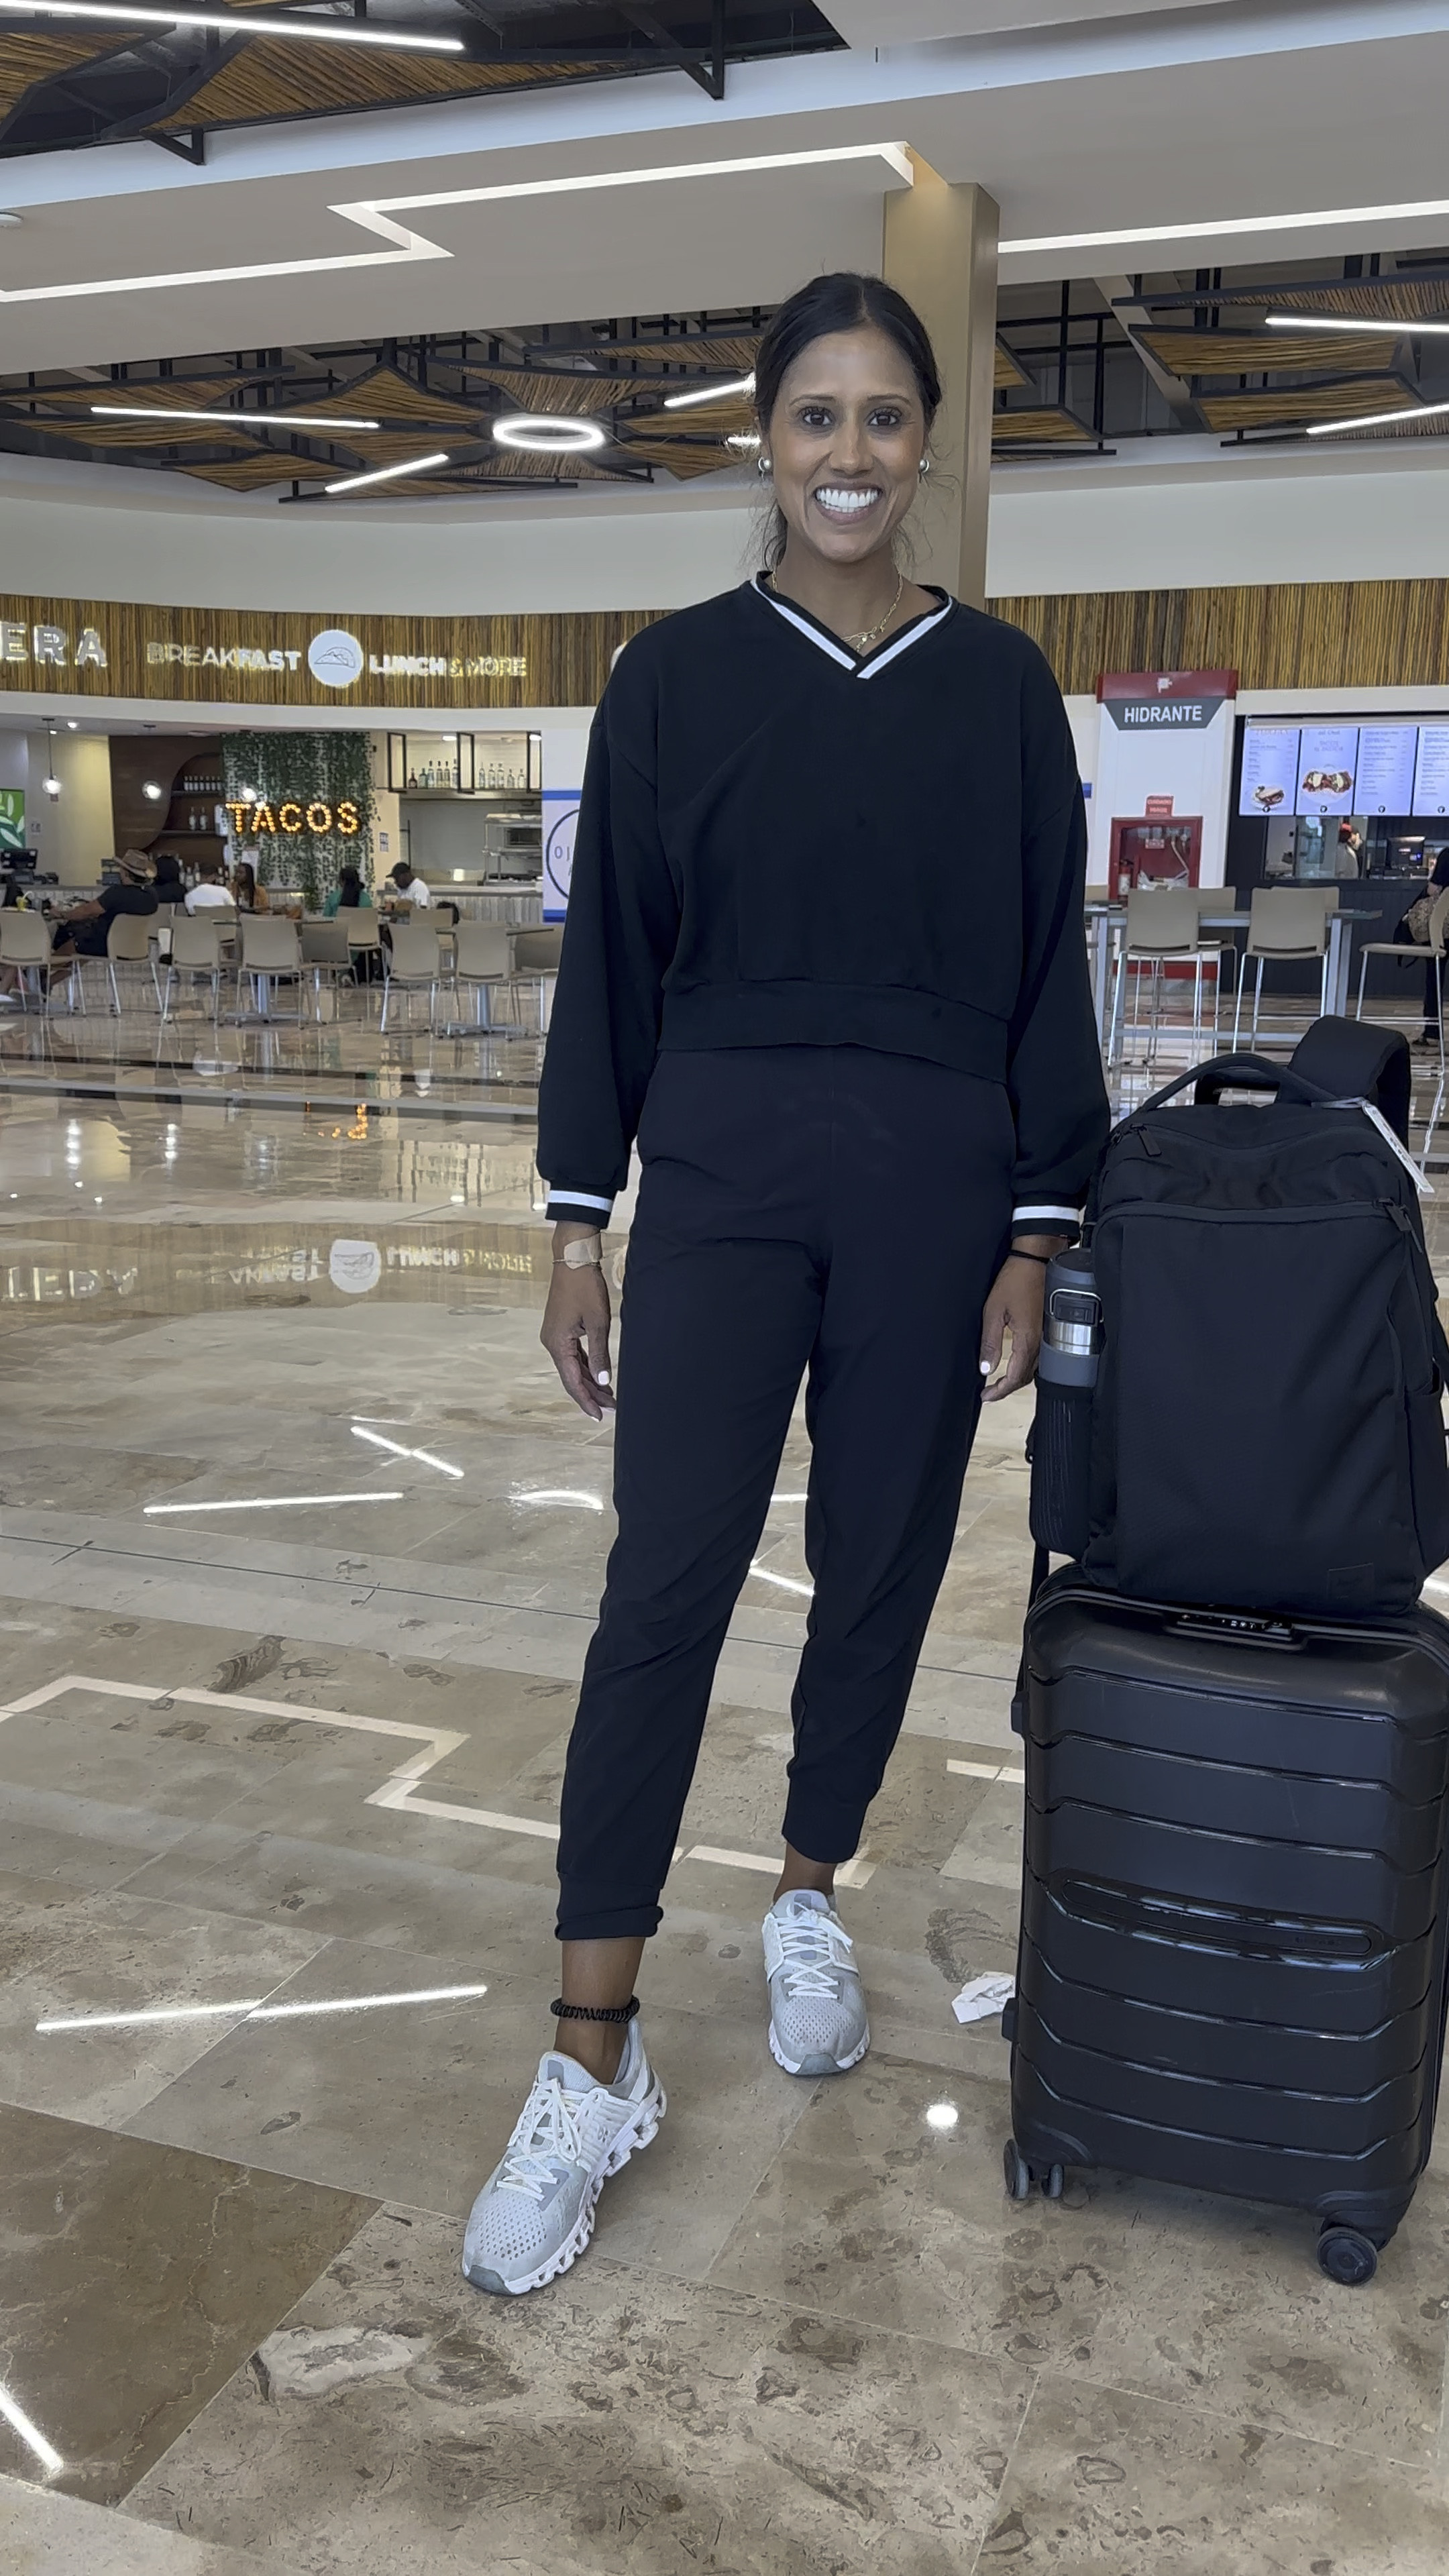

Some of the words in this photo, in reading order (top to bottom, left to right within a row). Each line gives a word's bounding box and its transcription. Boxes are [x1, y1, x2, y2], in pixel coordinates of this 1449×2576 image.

[0, 621, 107, 667] ERA
[146, 642, 301, 672] BREAKFAST
[369, 653, 445, 676] LUNCH
[467, 655, 527, 677] MORE
[1124, 704, 1203, 724] HIDRANTE
[225, 800, 358, 834] TACOS
